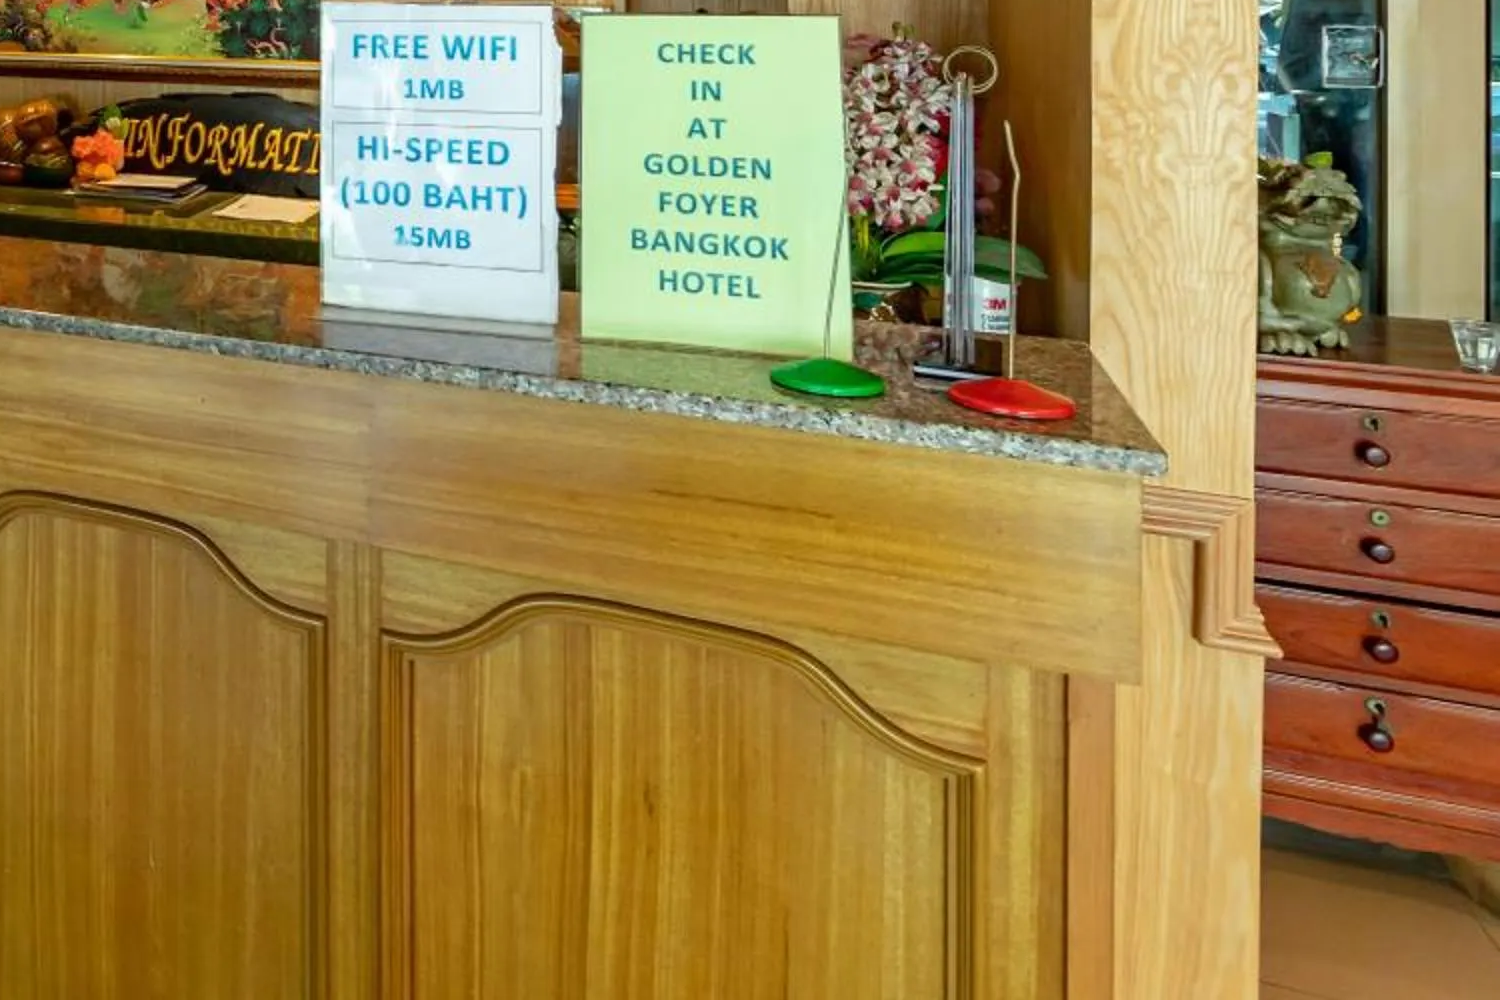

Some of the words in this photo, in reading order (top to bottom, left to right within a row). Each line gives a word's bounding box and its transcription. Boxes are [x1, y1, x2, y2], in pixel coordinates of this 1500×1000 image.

[353, 34, 429, 62] FREE
[441, 35, 518, 63] WIFI
[657, 43, 757, 66] CHECK
[404, 79, 465, 101] 1MB
[691, 81, 722, 102] IN
[687, 118, 728, 140] AT
[357, 136, 510, 166] HI-SPEED
[643, 153, 772, 181] GOLDEN
[340, 178, 411, 209] (100
[423, 184, 528, 219] BAHT)
[658, 192, 760, 219] FOYER
[394, 226, 471, 250] 15MB
[631, 228, 790, 261] BANGKOK
[659, 270, 761, 300] HOTEL
